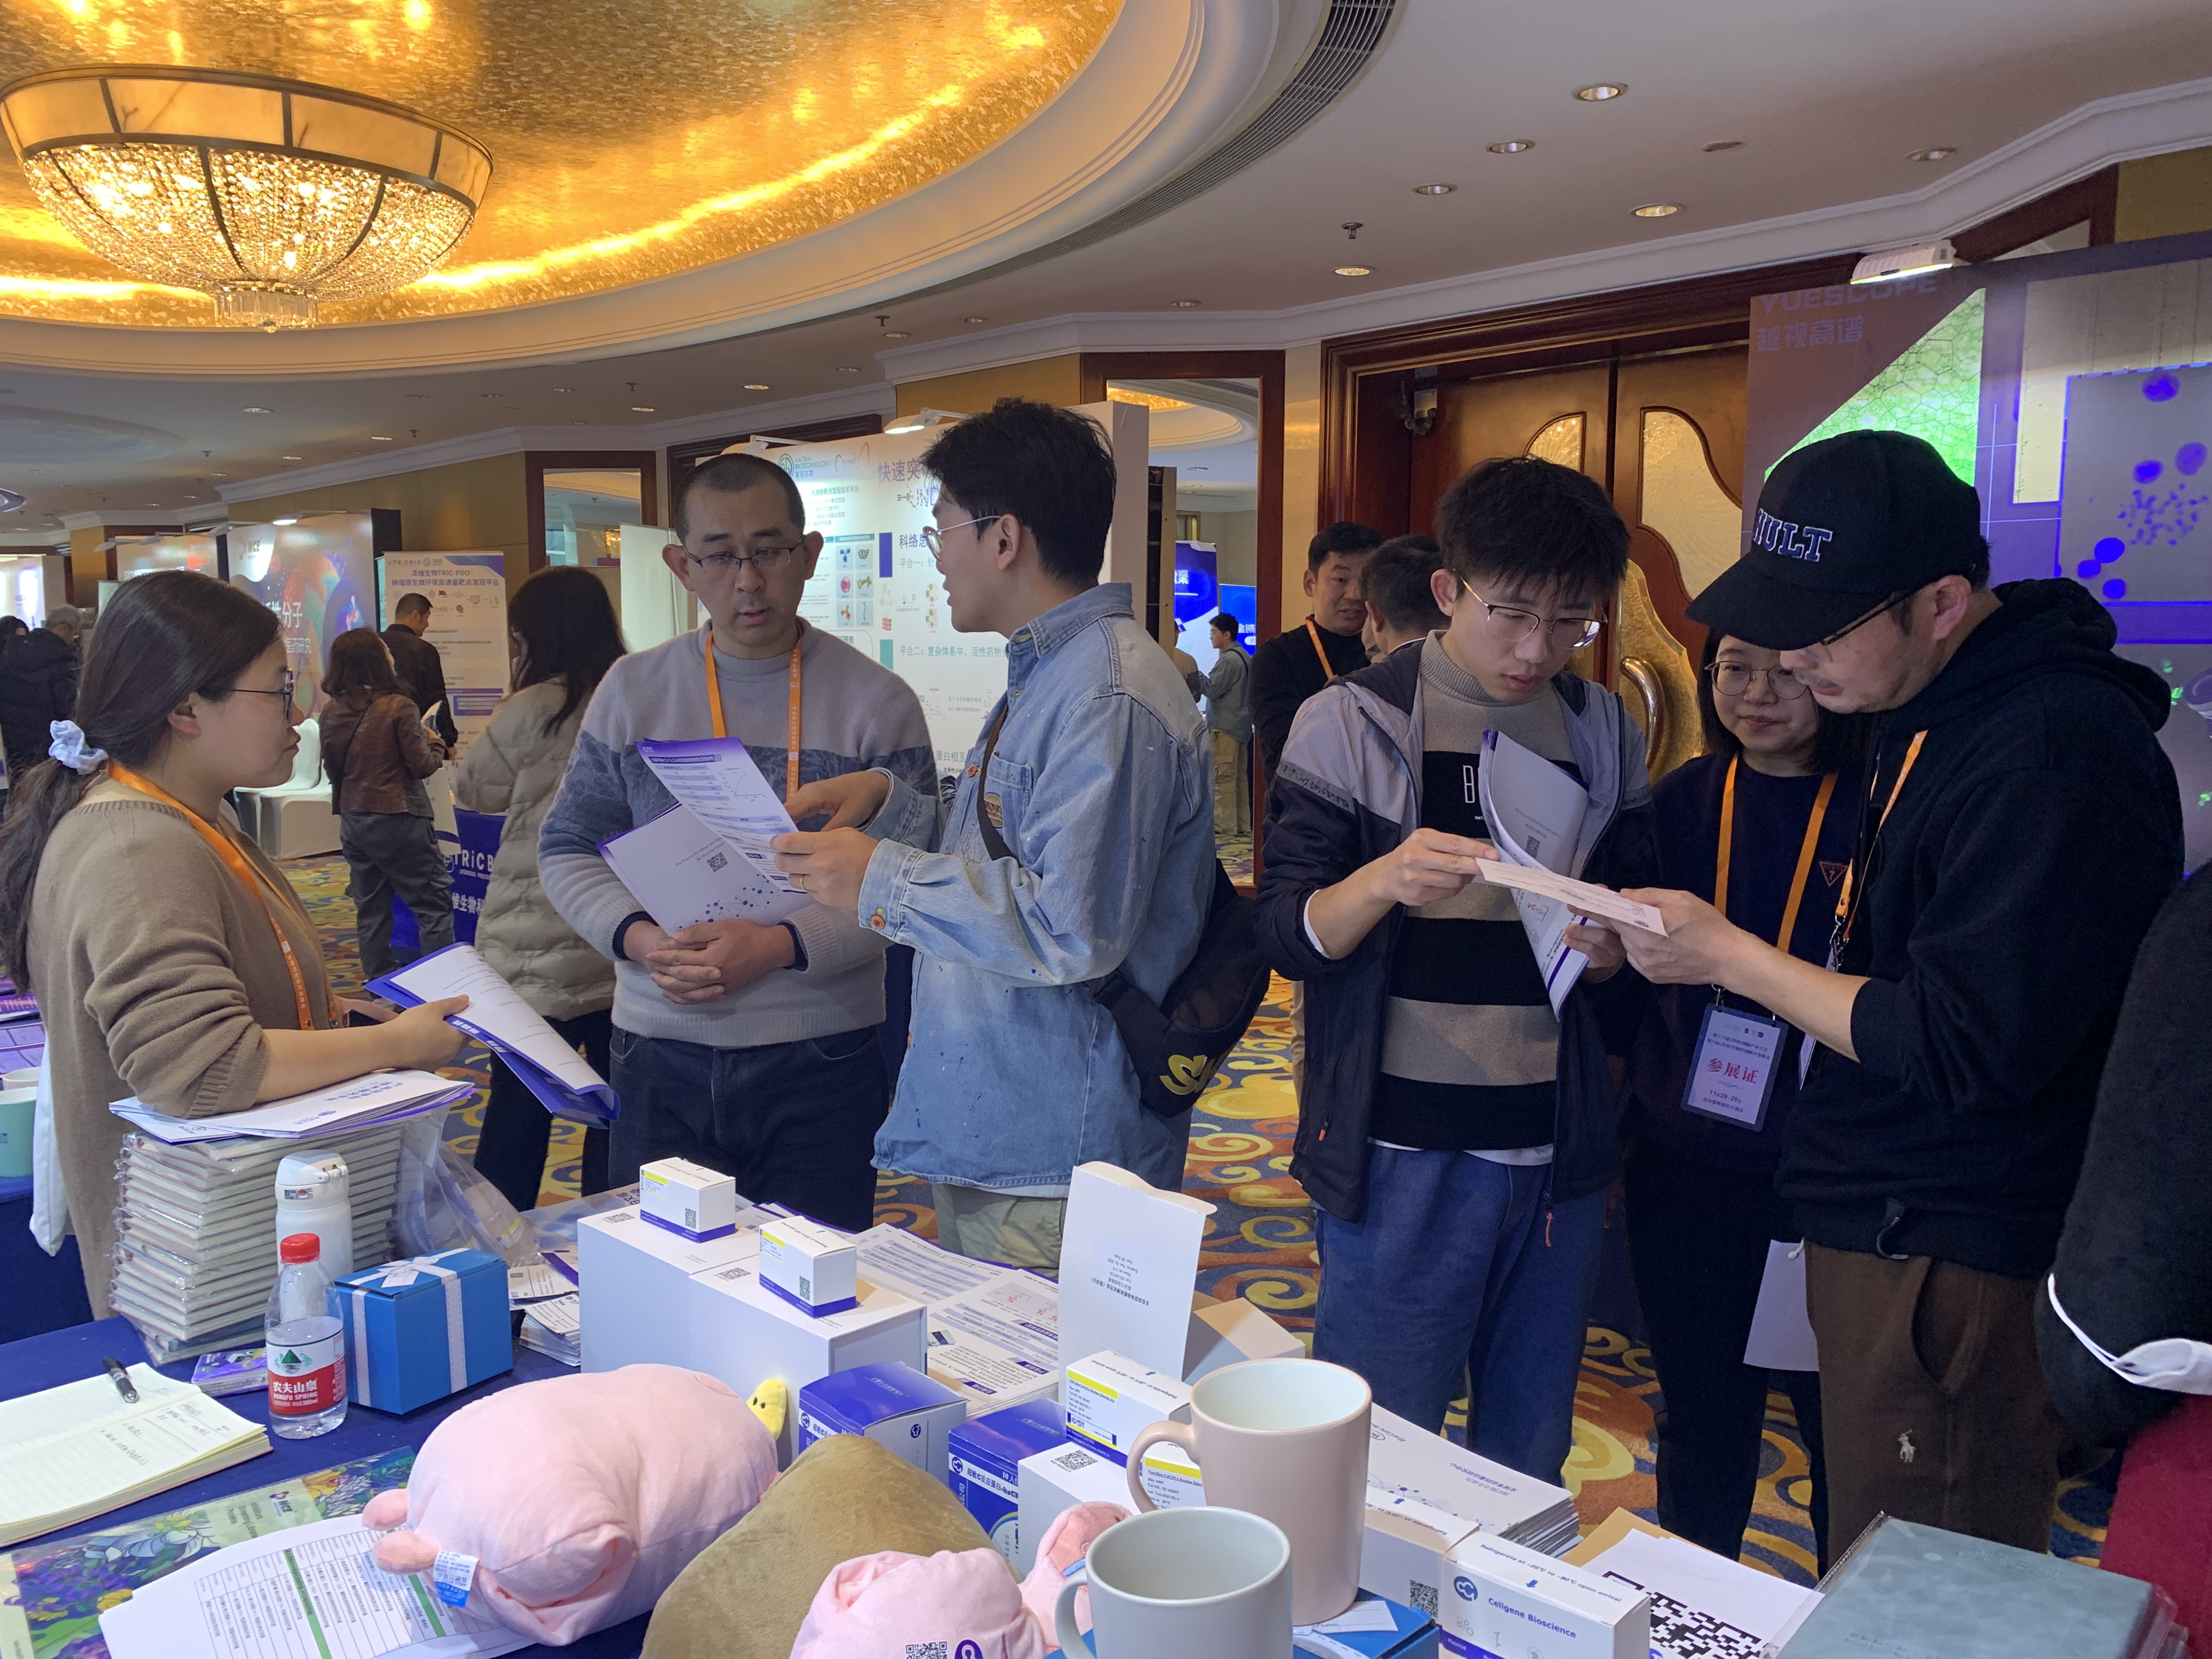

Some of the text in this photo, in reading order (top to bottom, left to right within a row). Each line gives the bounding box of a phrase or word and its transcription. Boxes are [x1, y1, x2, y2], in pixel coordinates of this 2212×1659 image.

[878, 458, 927, 484] 快速突
[1707, 1057, 1759, 1085] 参展证
[273, 1380, 318, 1393] 农夫山泉
[295, 1391, 318, 1400] SPRING
[1480, 1543, 1517, 1561] Refrigerate
[1577, 1583, 1598, 1594] upon
[1597, 1589, 1623, 1602] arrival
[1488, 1598, 1577, 1639] Cellgene Bioscience
